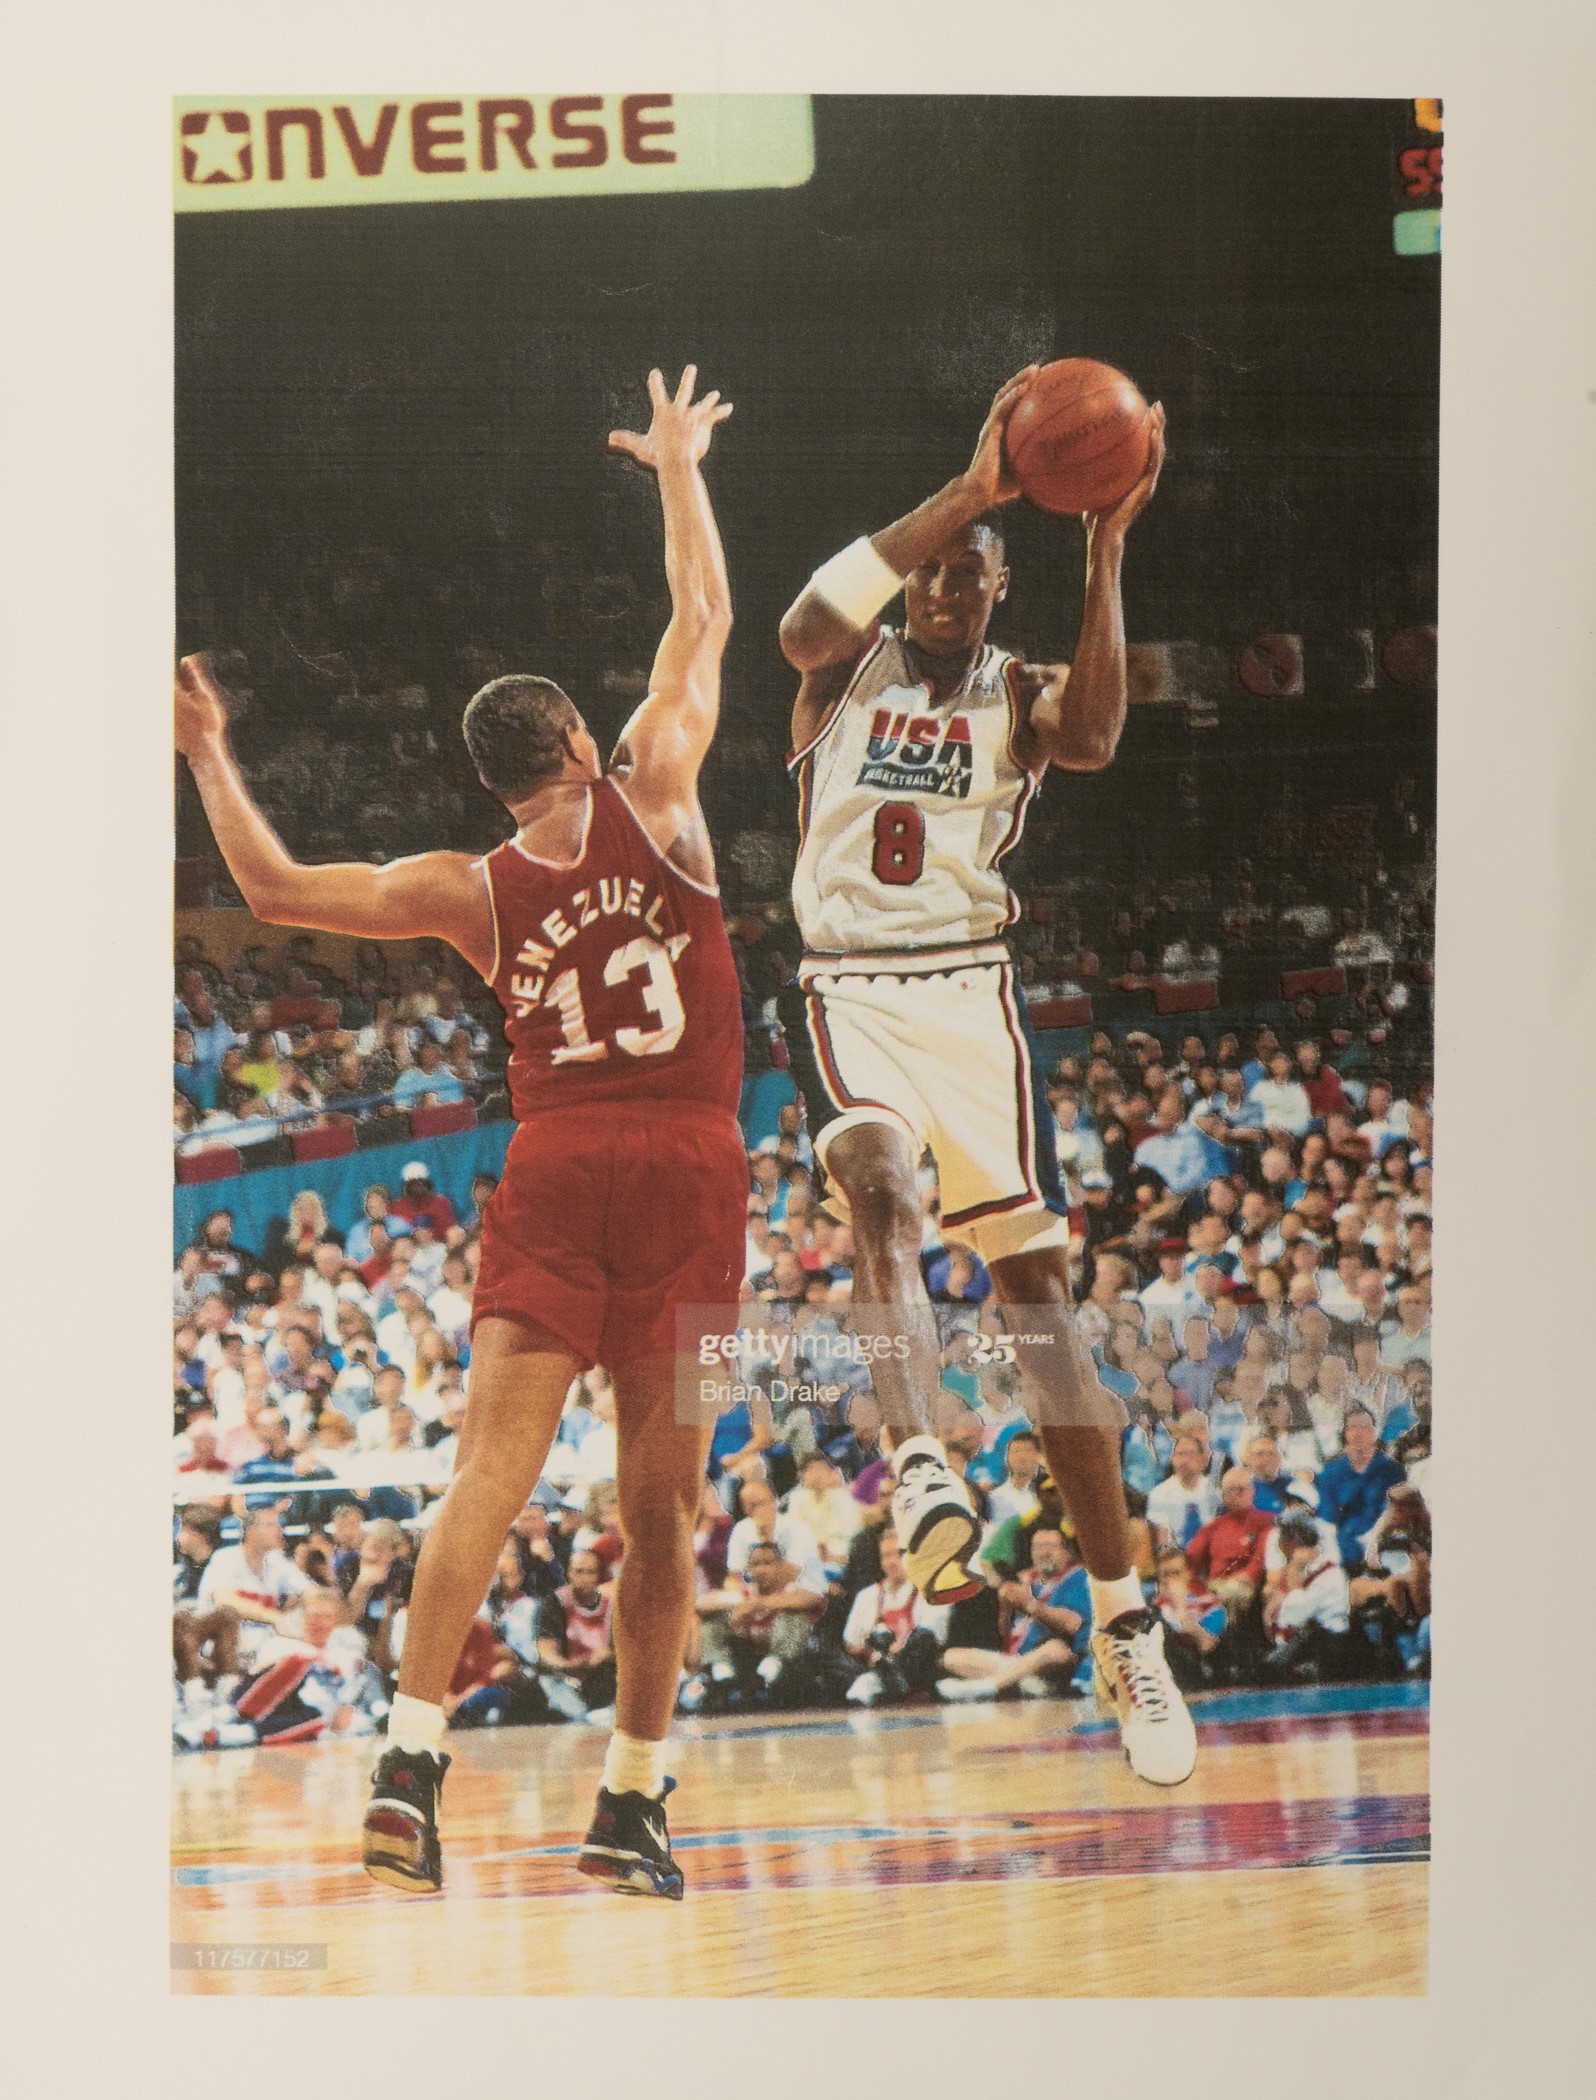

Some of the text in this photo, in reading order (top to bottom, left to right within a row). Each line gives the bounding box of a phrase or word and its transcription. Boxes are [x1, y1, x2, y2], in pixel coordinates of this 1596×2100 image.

[867, 709, 973, 769] USA
[872, 801, 925, 886] 8
[544, 936, 686, 1065] 13
